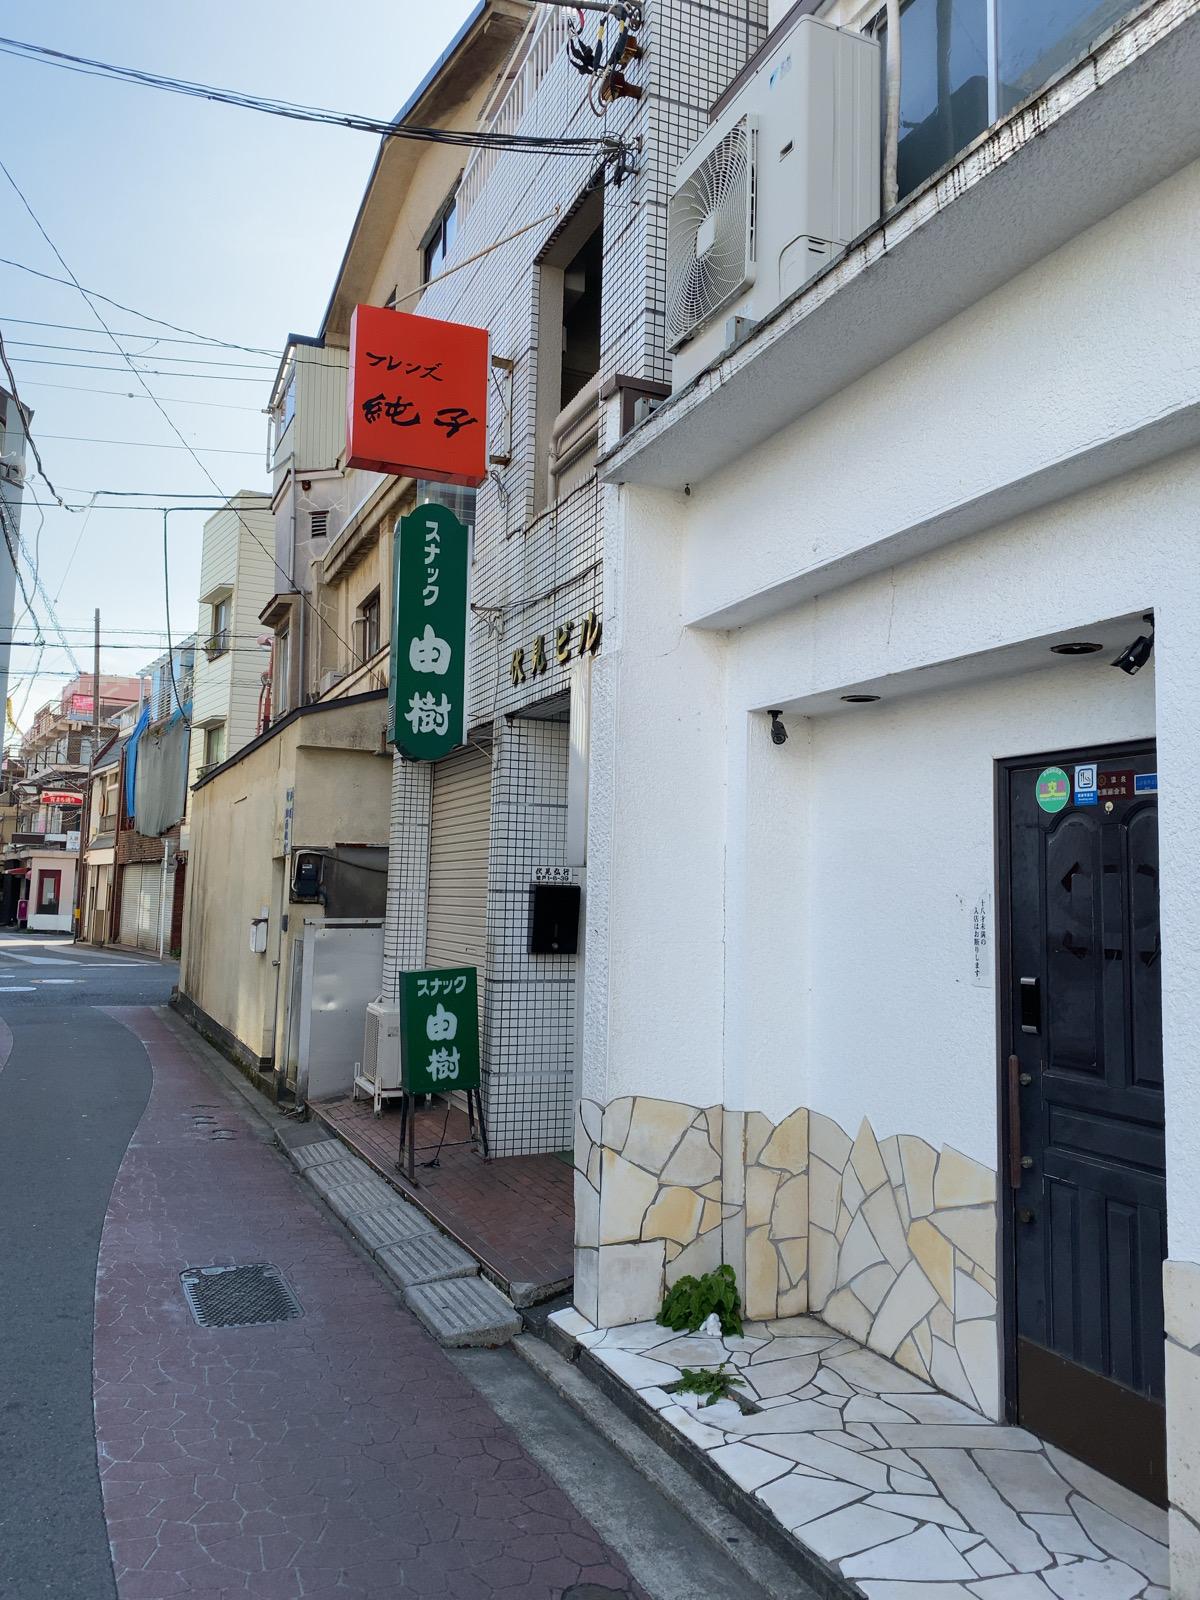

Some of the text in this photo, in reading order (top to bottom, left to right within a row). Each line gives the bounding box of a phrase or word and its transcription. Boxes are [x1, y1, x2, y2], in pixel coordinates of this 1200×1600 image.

[366, 351, 443, 381] フレンズ
[404, 520, 451, 736] スナック 由樹
[417, 975, 467, 997] スナック
[426, 1002, 461, 1082] 由樹
